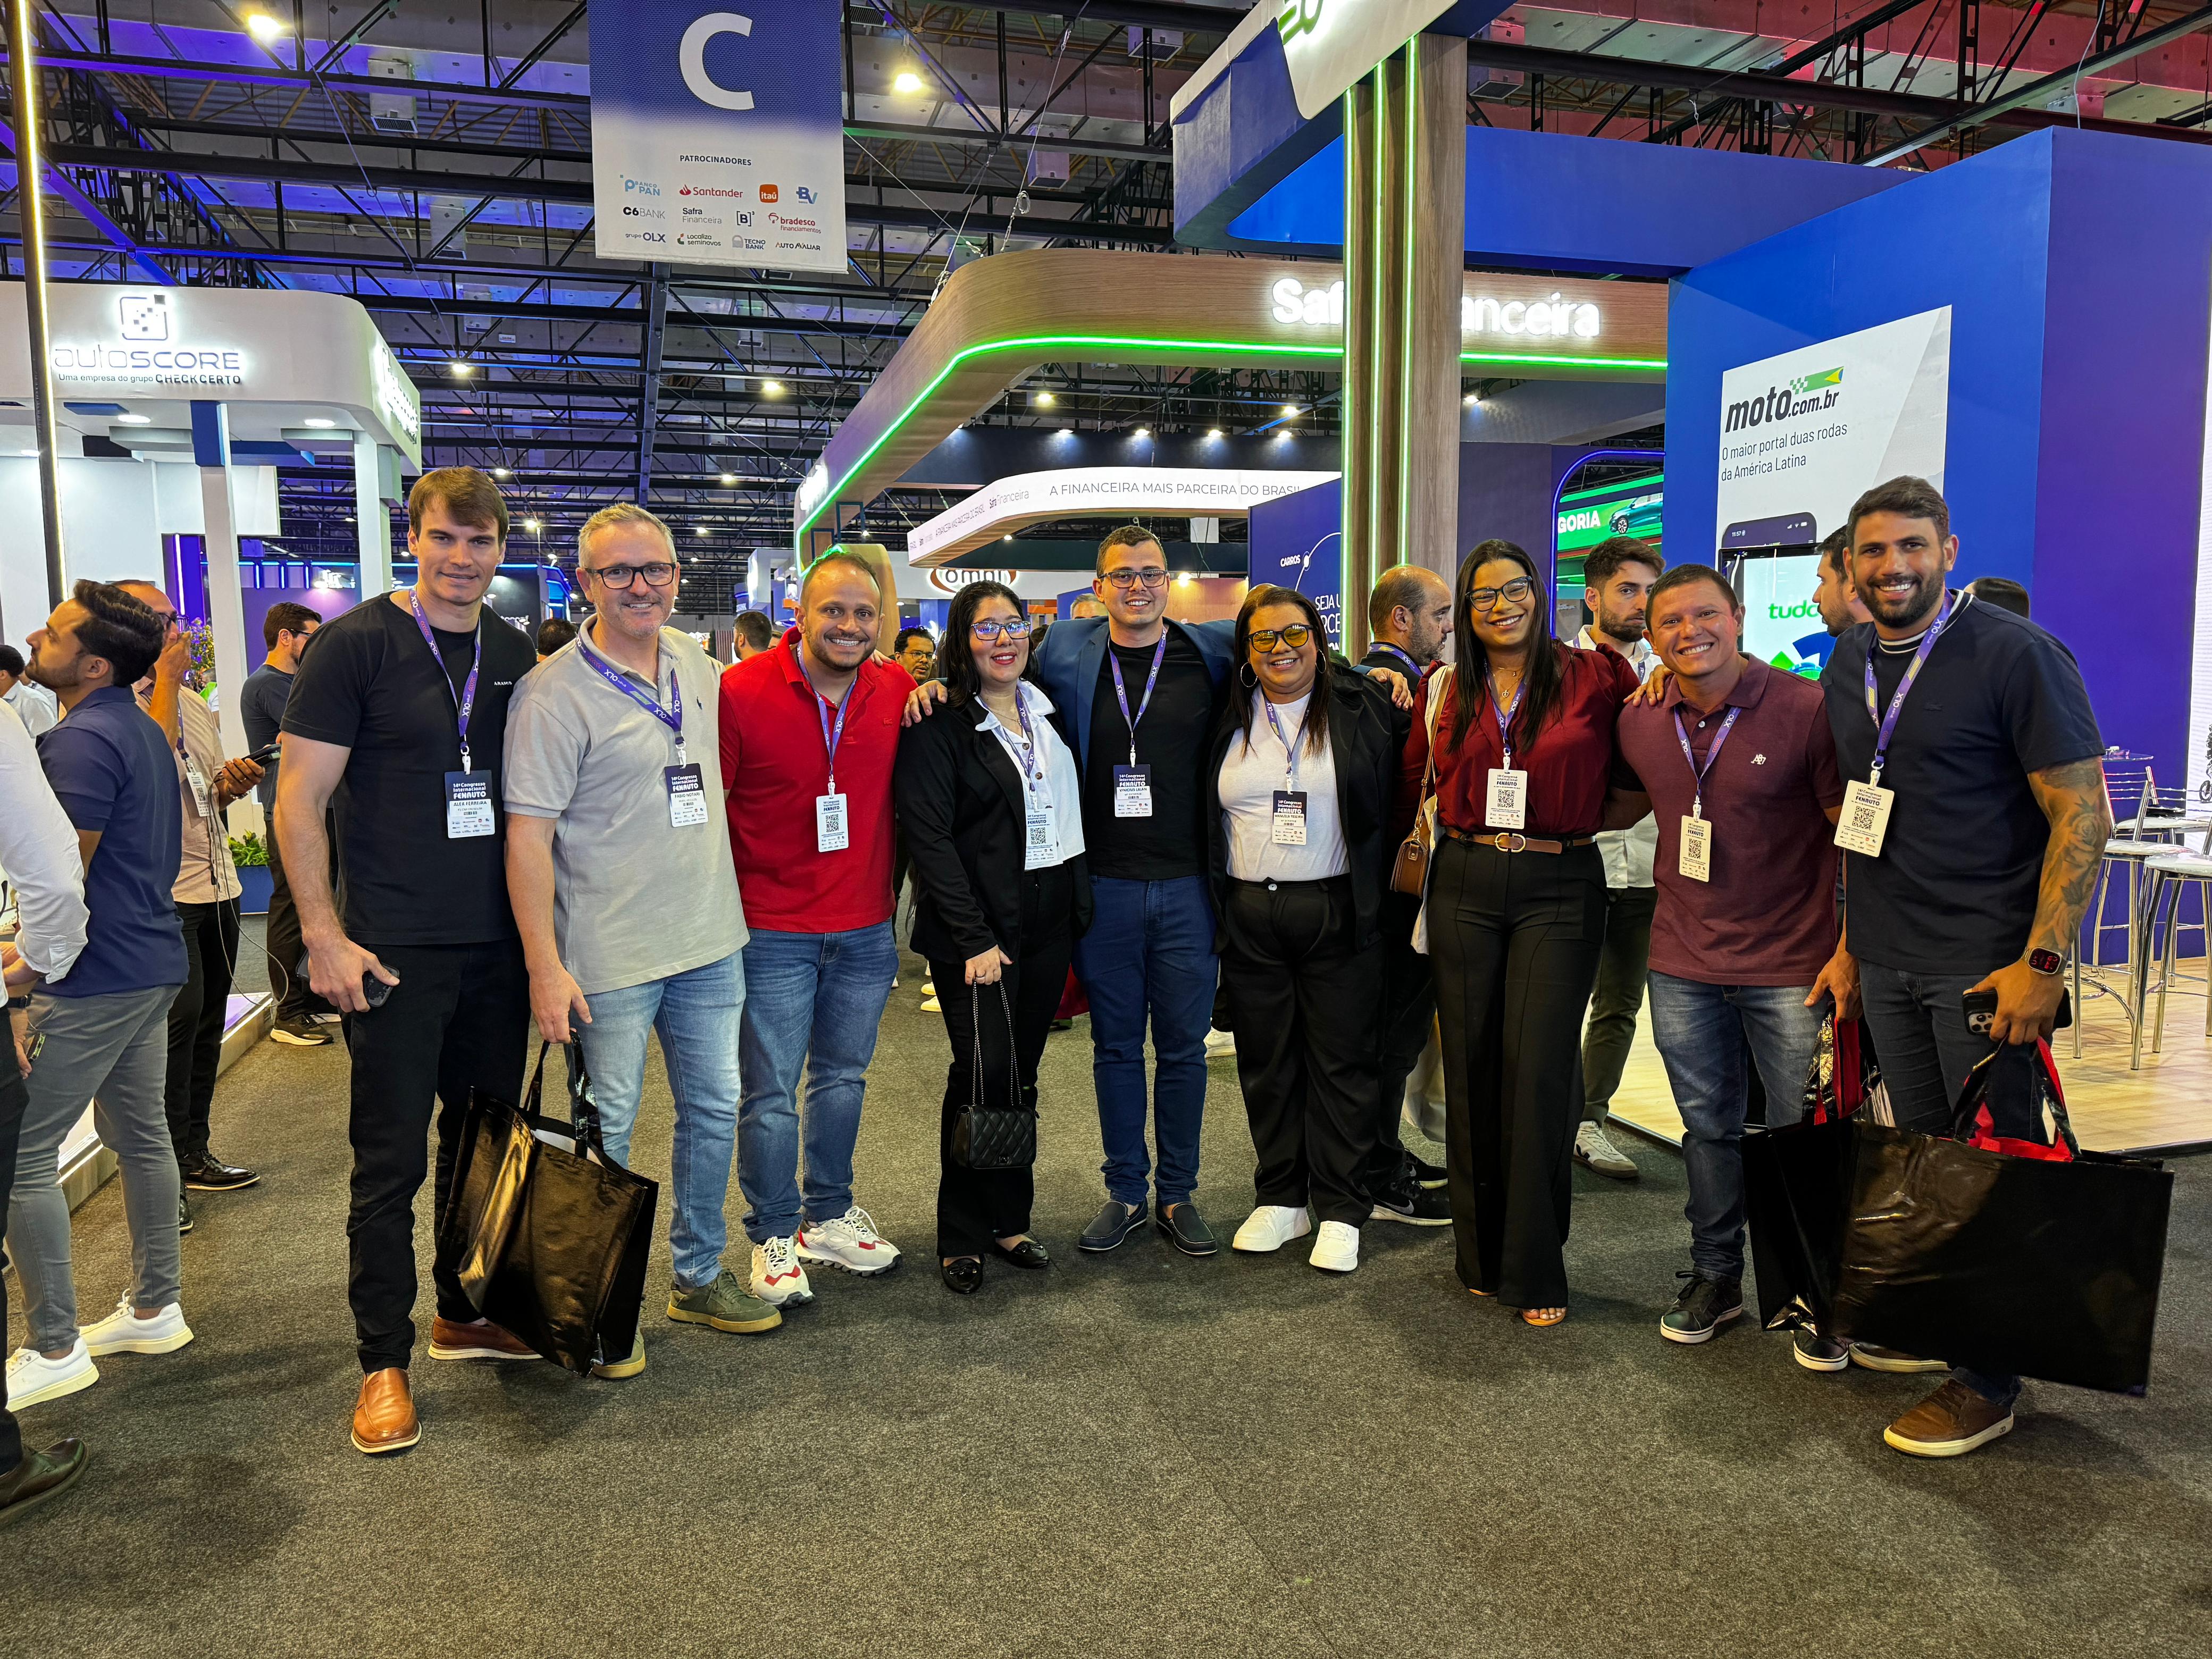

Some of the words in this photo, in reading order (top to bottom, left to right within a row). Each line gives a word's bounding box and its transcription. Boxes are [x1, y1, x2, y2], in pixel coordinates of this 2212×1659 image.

[680, 12, 755, 110] C
[680, 155, 751, 165] PATROCINADORES
[639, 187, 660, 196] PAN
[693, 187, 743, 198] Santander
[781, 217, 816, 226] bradesco
[643, 232, 666, 243] OLX
[1272, 278, 1344, 324] Saf
[1462, 292, 1601, 337] anceira
[155, 374, 241, 384] CHECKCERTO
[1722, 447, 1728, 460] O
[1730, 442, 1757, 459] maior
[1759, 434, 1787, 456] portal
[1790, 432, 1814, 446] duas
[1817, 423, 1847, 440] rodas
[1721, 468, 1732, 481] da
[1735, 461, 1772, 479] América
[1775, 454, 1806, 471] Latina
[1050, 485, 1058, 496] A
[1061, 482, 1139, 495] FINANCEIRA
[1143, 483, 1173, 493] MAIS
[1177, 483, 1237, 495] PARCEIRA
[1241, 485, 1259, 495] DO
[1557, 510, 1601, 533] GORIA
[1280, 554, 1301, 567] CARROS
[1315, 594, 1335, 611] SEJA
[1931, 618, 1943, 633] OLX
[429, 640, 438, 655] OLX
[604, 669, 618, 681] OLX
[1893, 692, 1904, 708] OLX
[462, 702, 471, 716] OLX
[654, 707, 667, 718] OLX
[1724, 714, 1735, 727] OLX
[673, 783, 699, 792] FENAUTO
[454, 791, 487, 799] FENAUTO
[1856, 796, 1880, 806] FENAUTO
